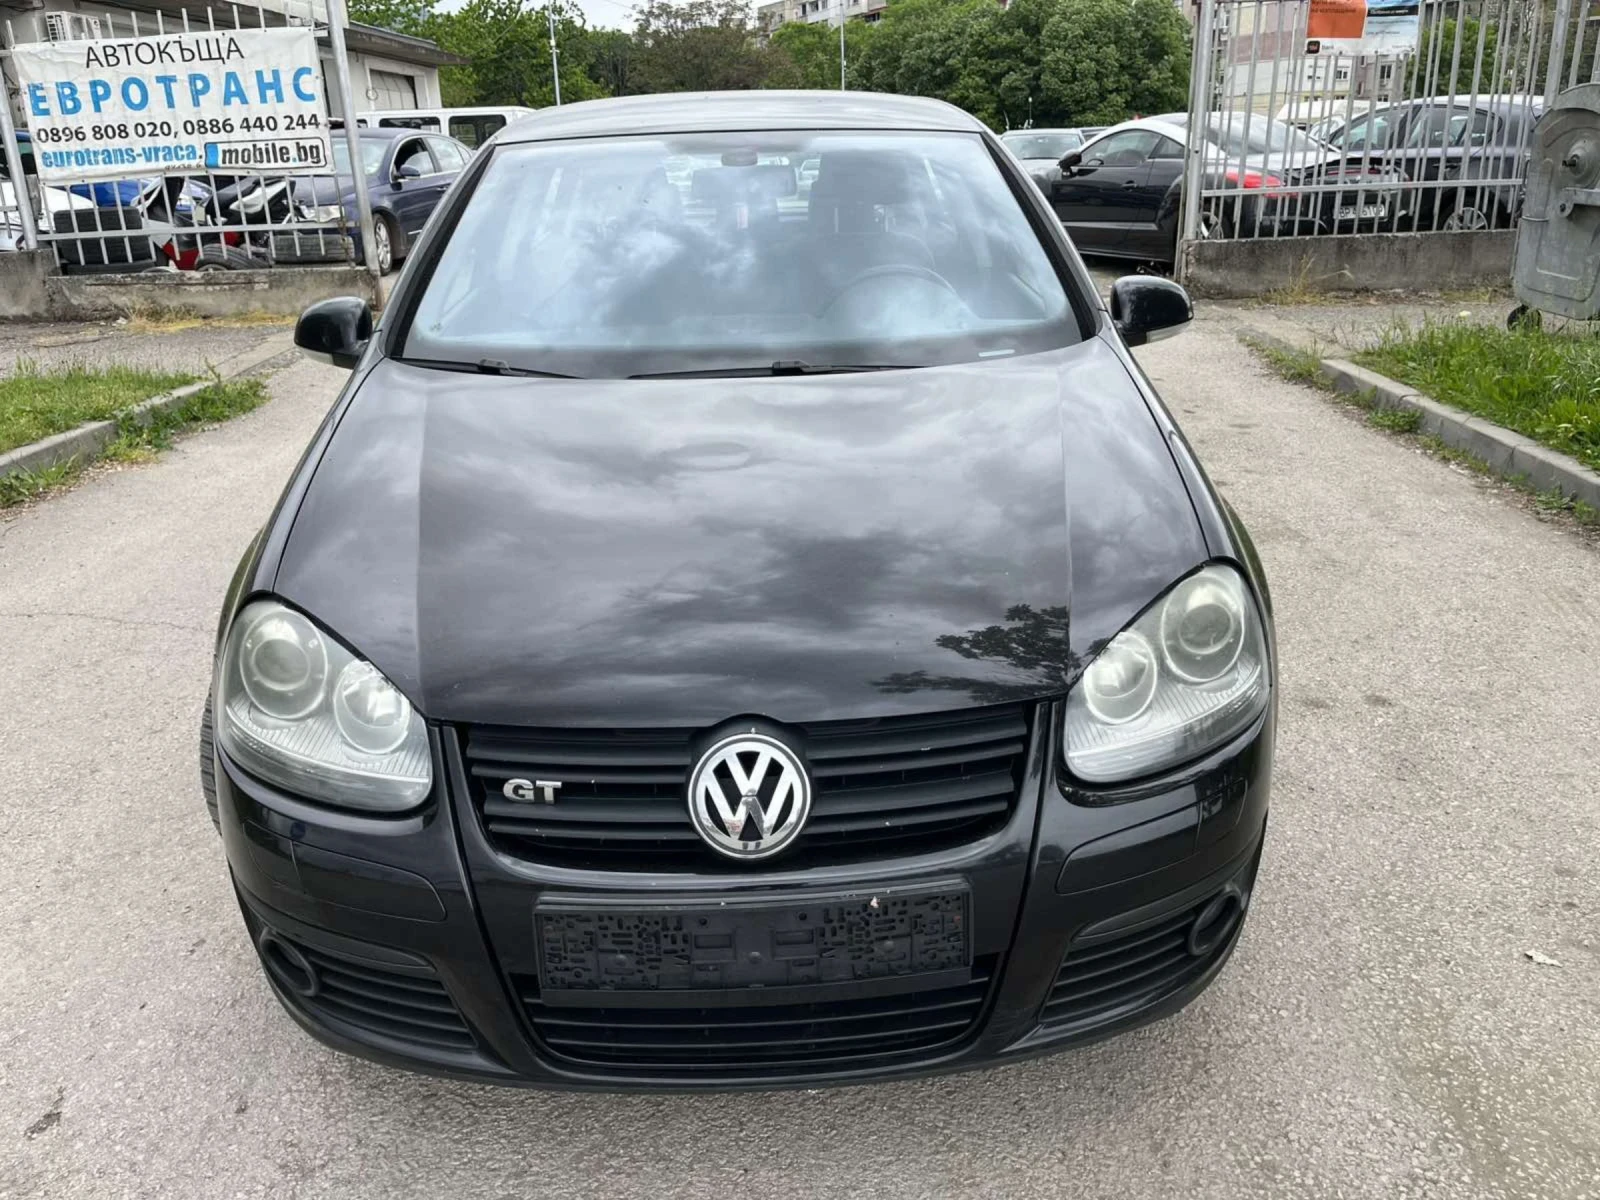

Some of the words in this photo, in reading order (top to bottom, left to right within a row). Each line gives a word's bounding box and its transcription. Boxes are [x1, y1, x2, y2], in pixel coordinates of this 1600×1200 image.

[85, 37, 245, 69] АВТОКЪЩА
[27, 66, 318, 116] ЕВРОТРАНС
[36, 126, 86, 143] 0896
[92, 123, 129, 140] 808
[134, 121, 179, 139] 020,
[183, 117, 235, 136] 0886
[240, 114, 278, 132] 440
[283, 113, 320, 130] 244
[503, 778, 562, 805] GT
